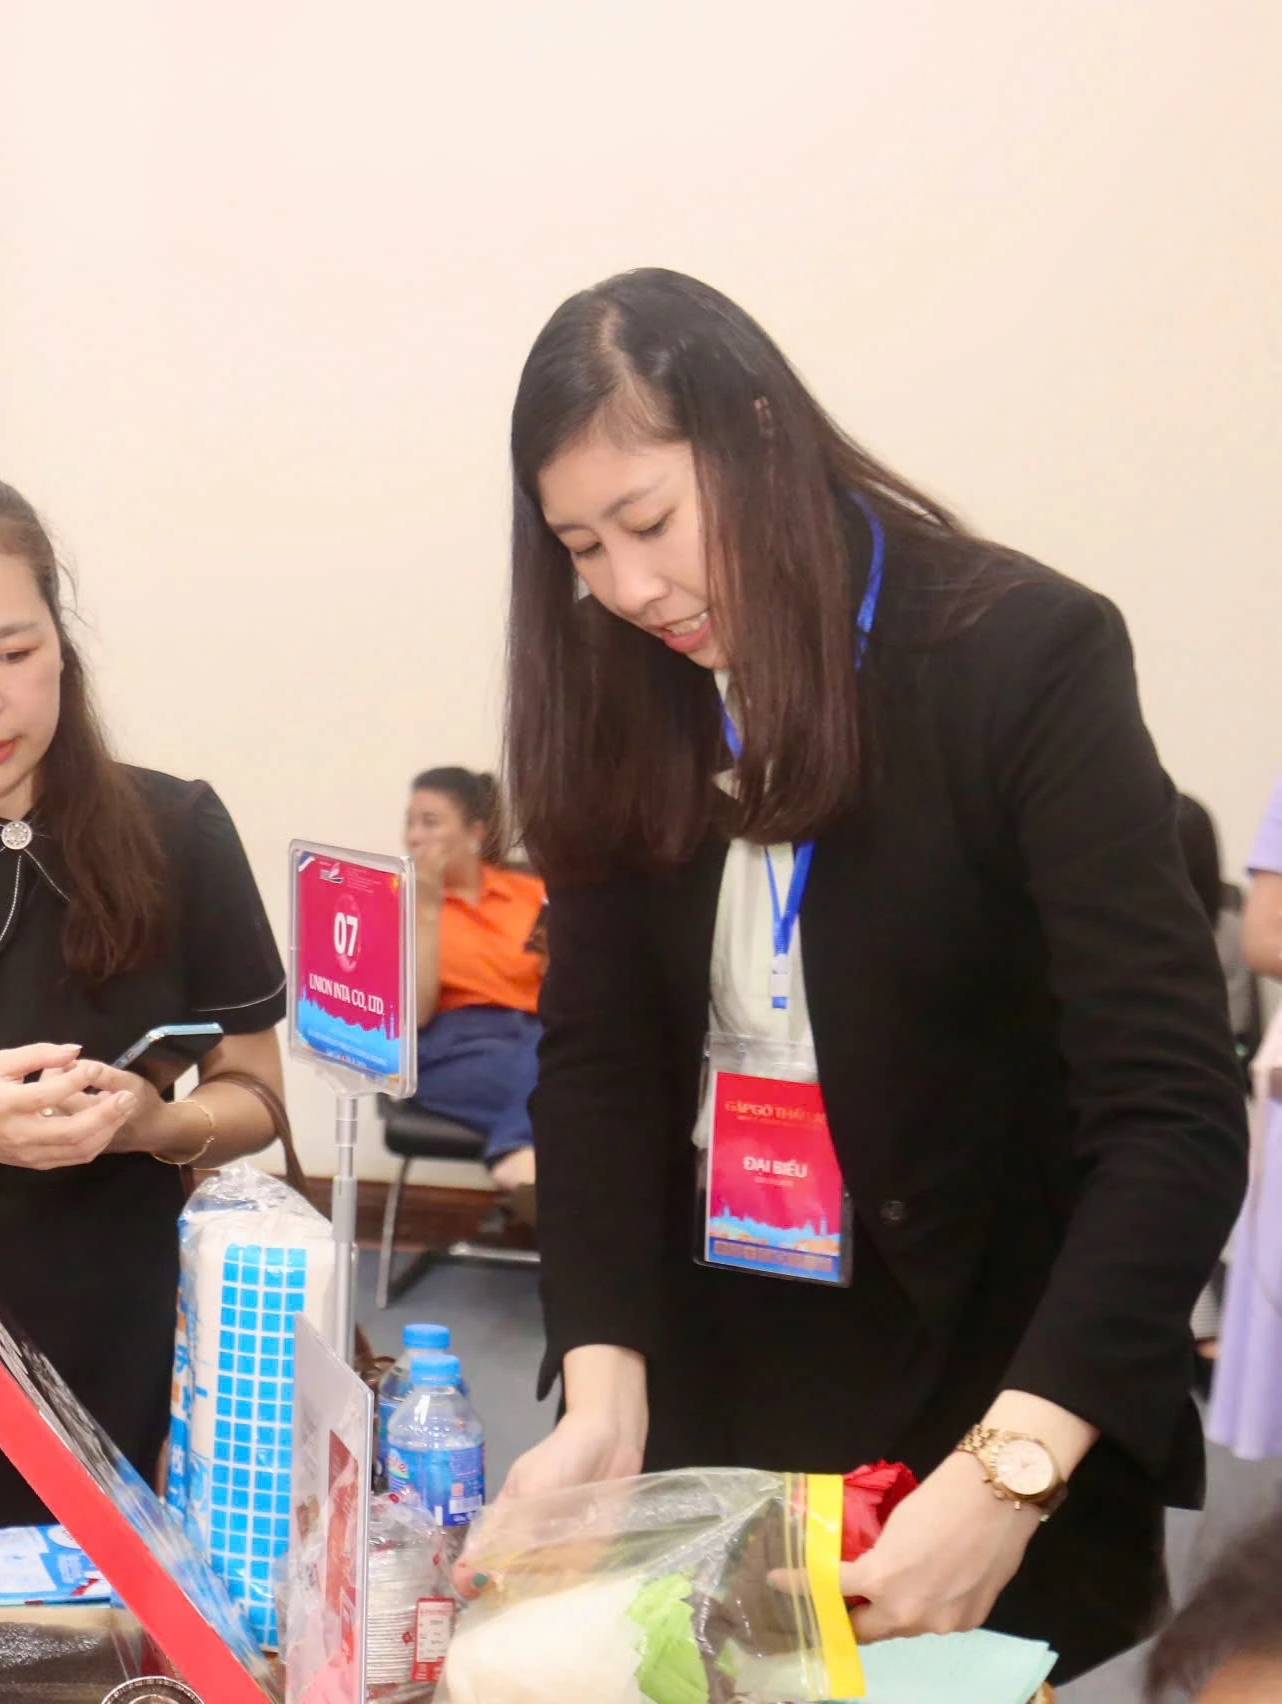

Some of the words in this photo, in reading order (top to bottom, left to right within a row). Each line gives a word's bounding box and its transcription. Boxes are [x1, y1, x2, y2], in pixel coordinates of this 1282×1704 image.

[333, 912, 359, 957] 07
[309, 973, 333, 997] UNION
[333, 982, 351, 1004] INTA
